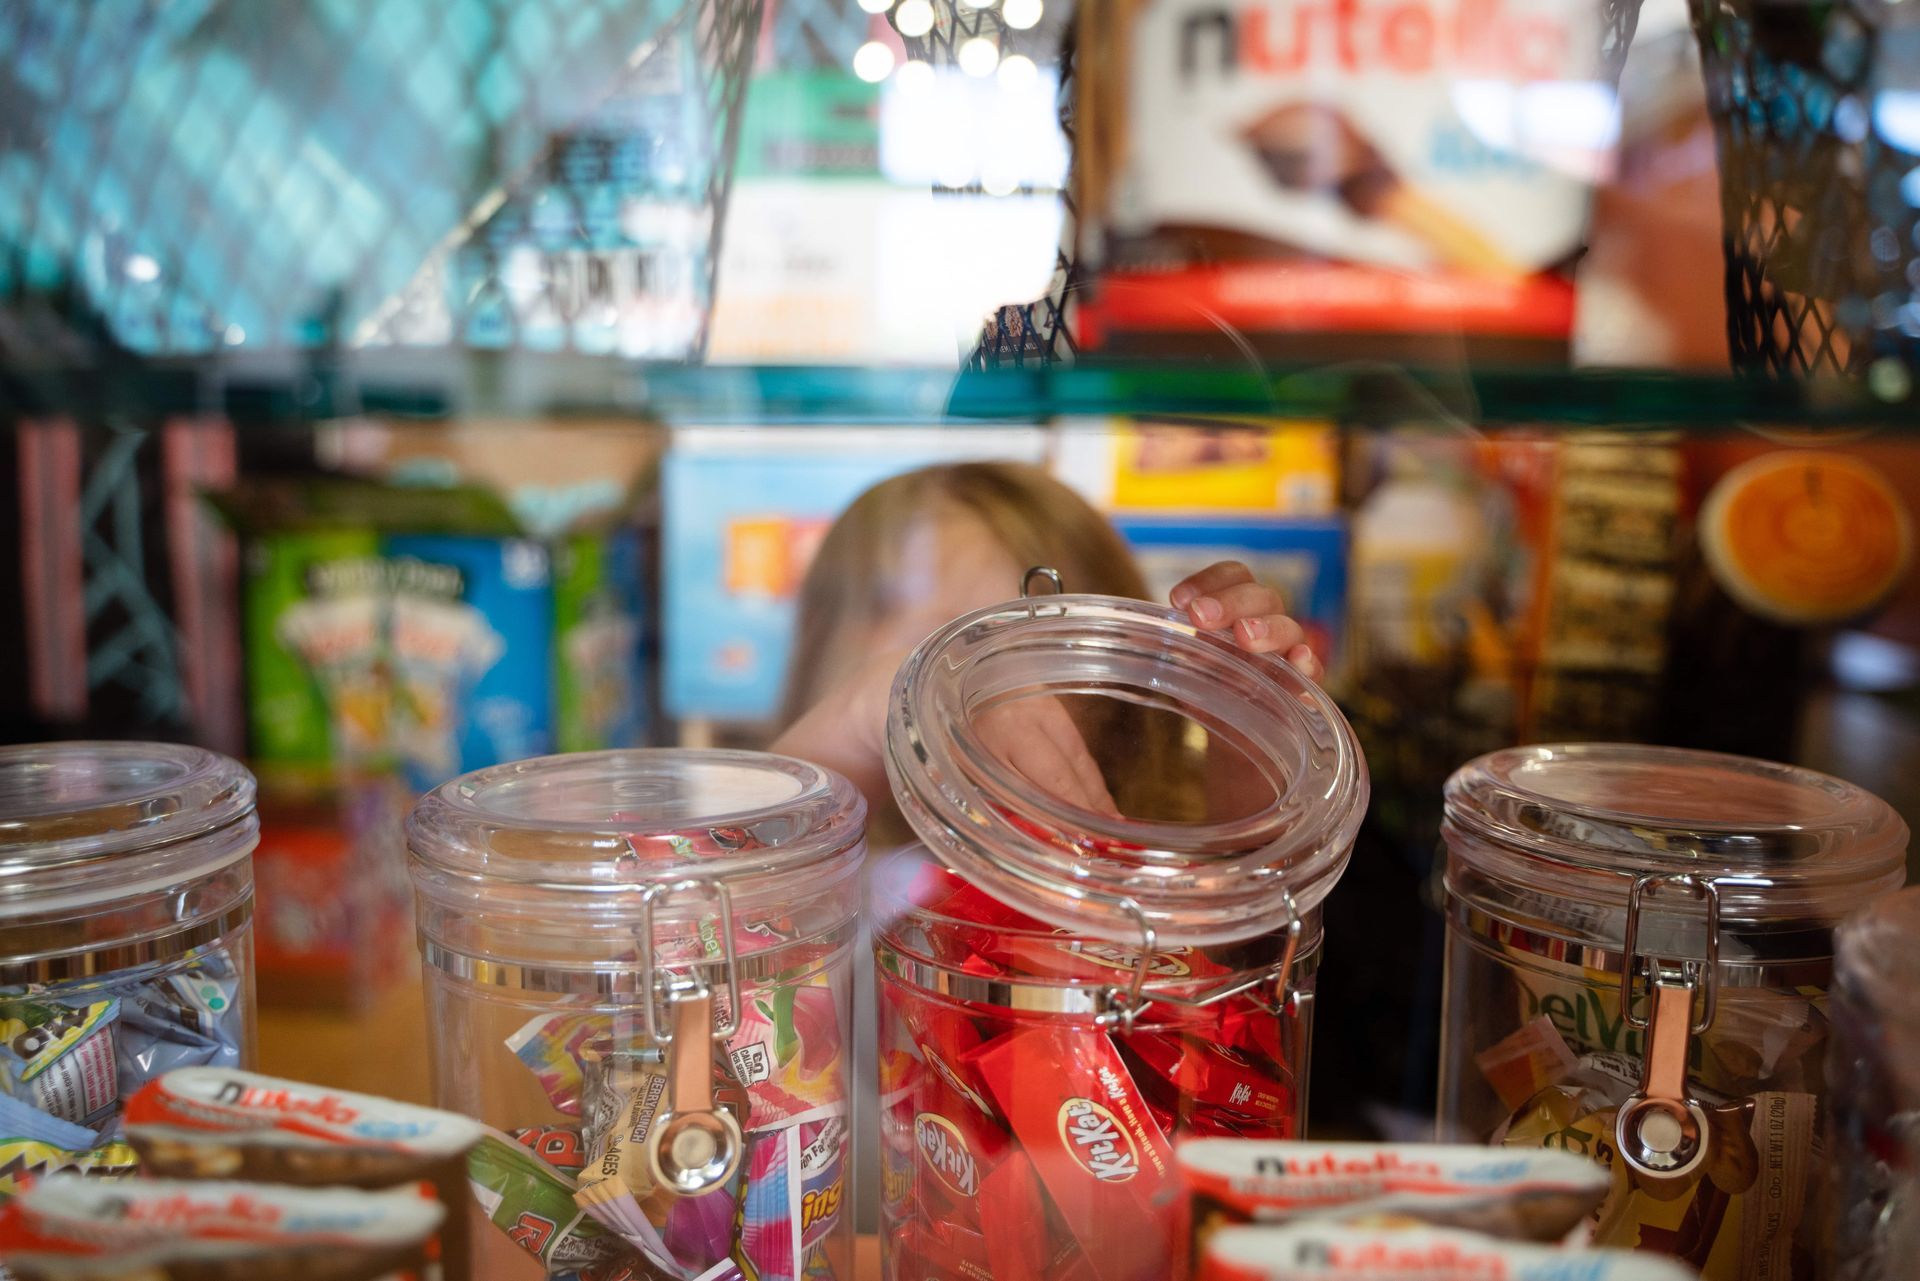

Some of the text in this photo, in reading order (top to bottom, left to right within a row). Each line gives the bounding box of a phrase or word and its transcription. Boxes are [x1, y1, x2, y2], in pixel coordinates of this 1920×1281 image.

[647, 1074, 667, 1110] BERRY
[630, 1107, 652, 1145] PUNCH
[1769, 1153, 1784, 1169] NET
